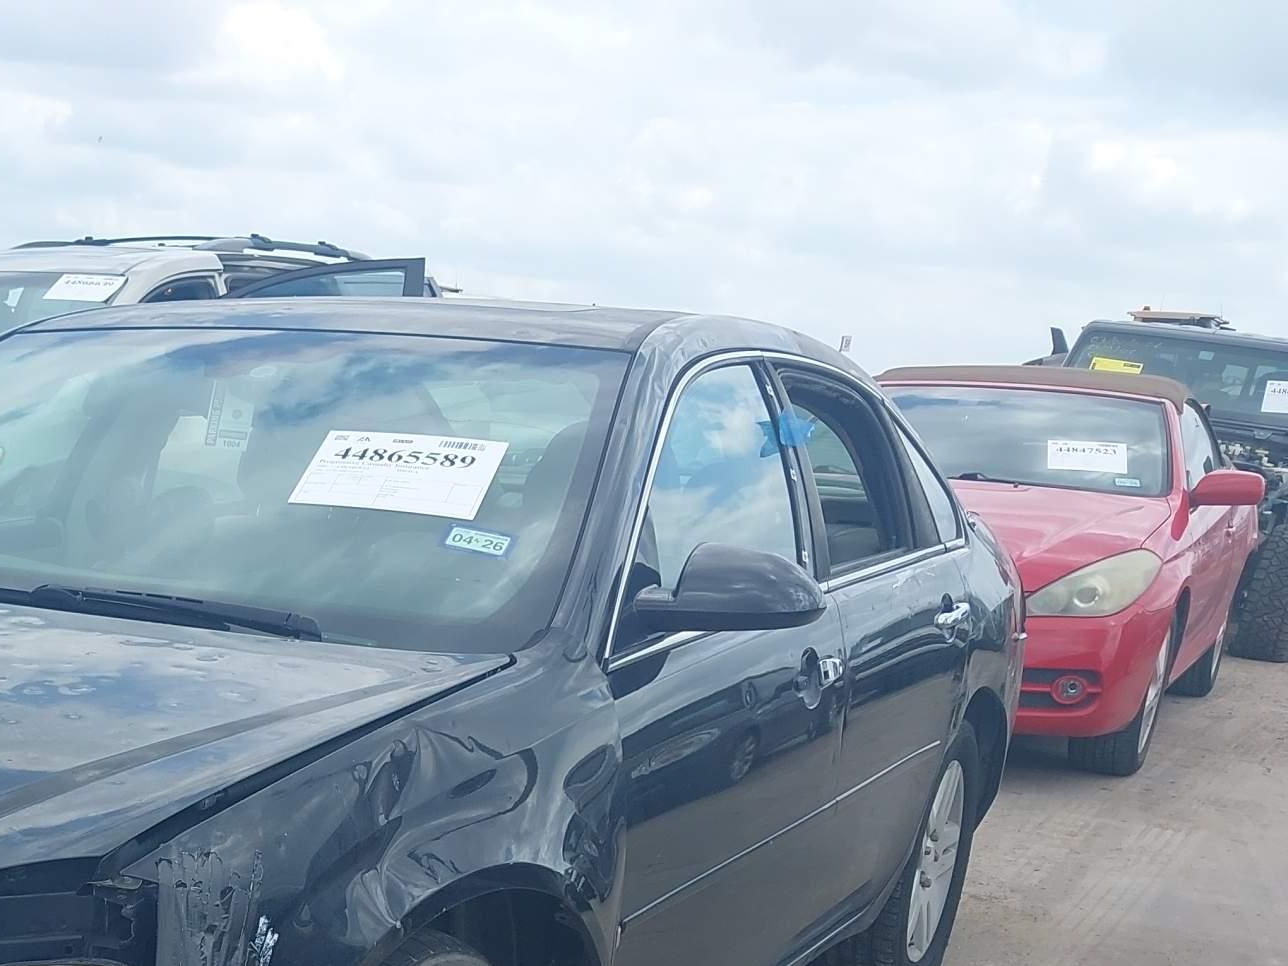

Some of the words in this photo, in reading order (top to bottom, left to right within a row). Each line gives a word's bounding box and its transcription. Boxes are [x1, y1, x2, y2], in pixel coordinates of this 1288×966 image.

[334, 446, 477, 469] 44865589
[451, 533, 474, 545] 04
[481, 539, 505, 552] 26
